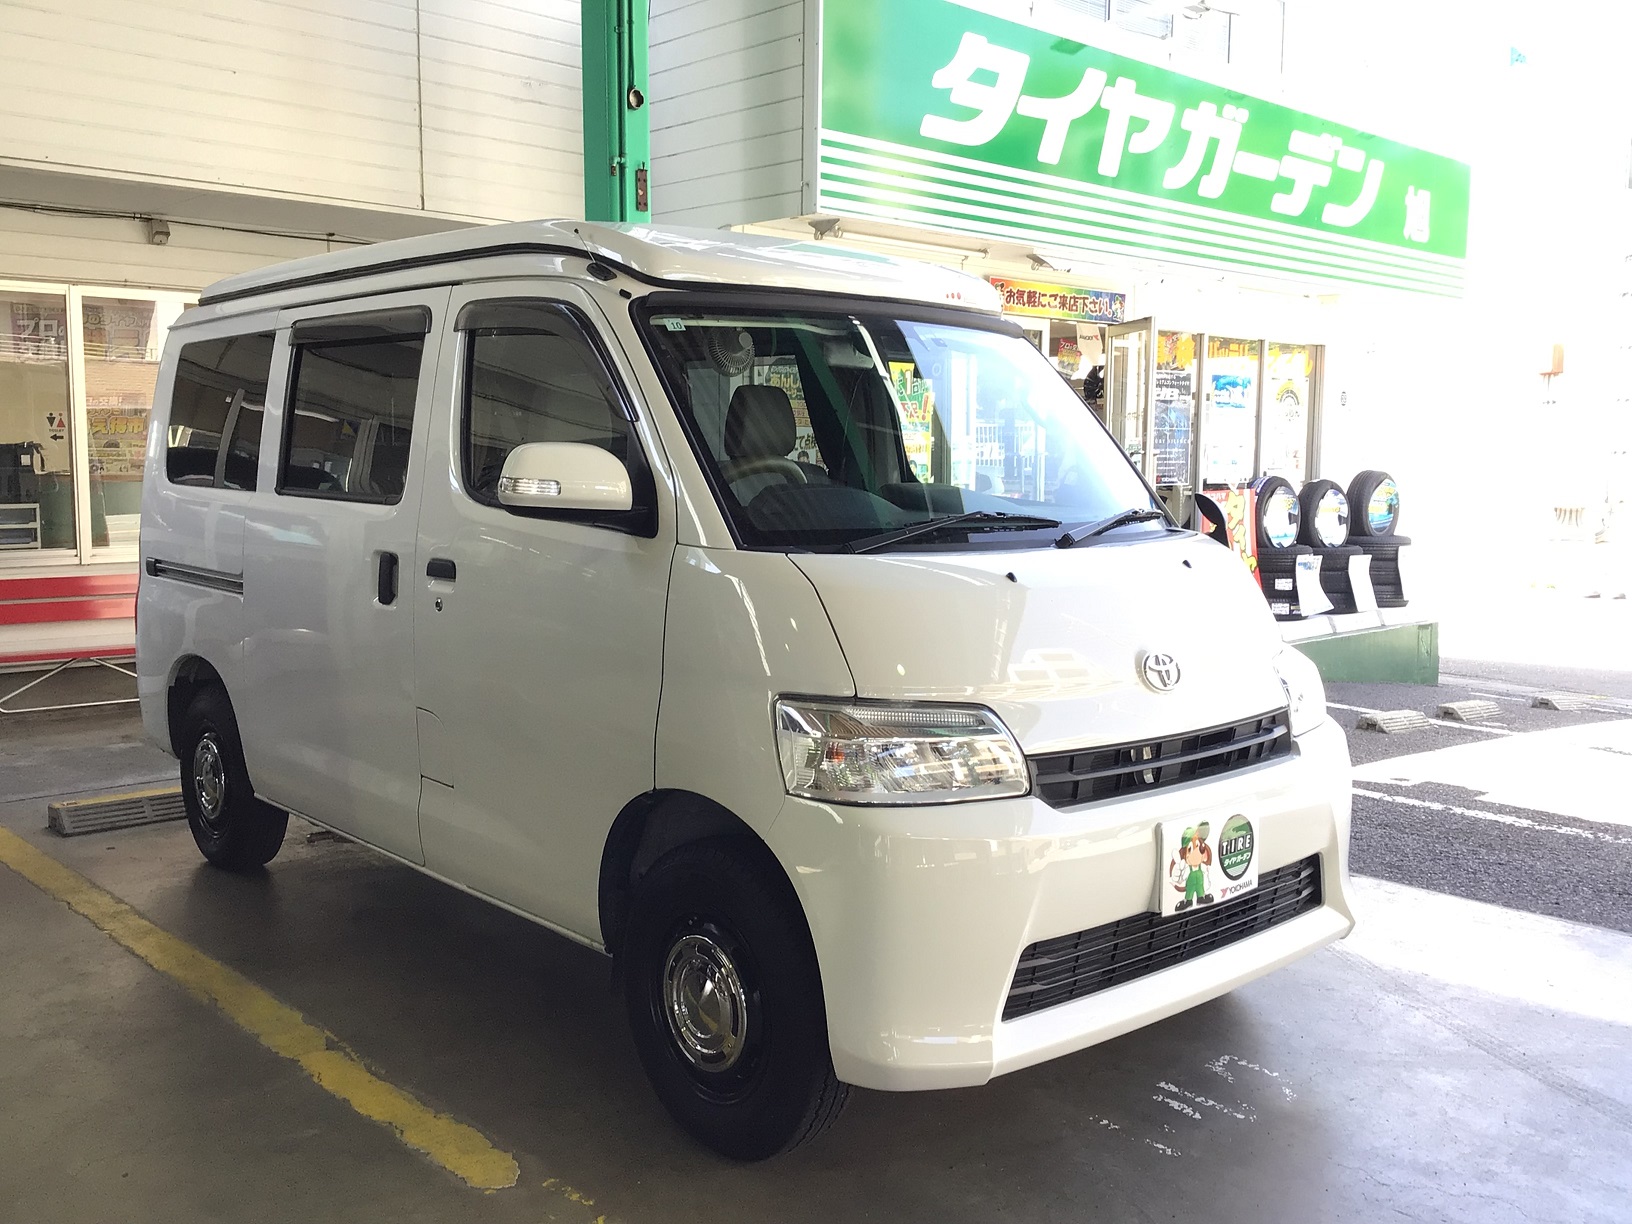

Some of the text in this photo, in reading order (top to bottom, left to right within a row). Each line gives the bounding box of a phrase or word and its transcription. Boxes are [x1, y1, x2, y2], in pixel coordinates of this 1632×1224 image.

[919, 30, 1385, 228] タイヤガーデン
[1005, 288, 1113, 317] お気軽にご来店下さい。
[1222, 835, 1251, 855] TIRE
[1229, 880, 1252, 894] YOKOHAMA
